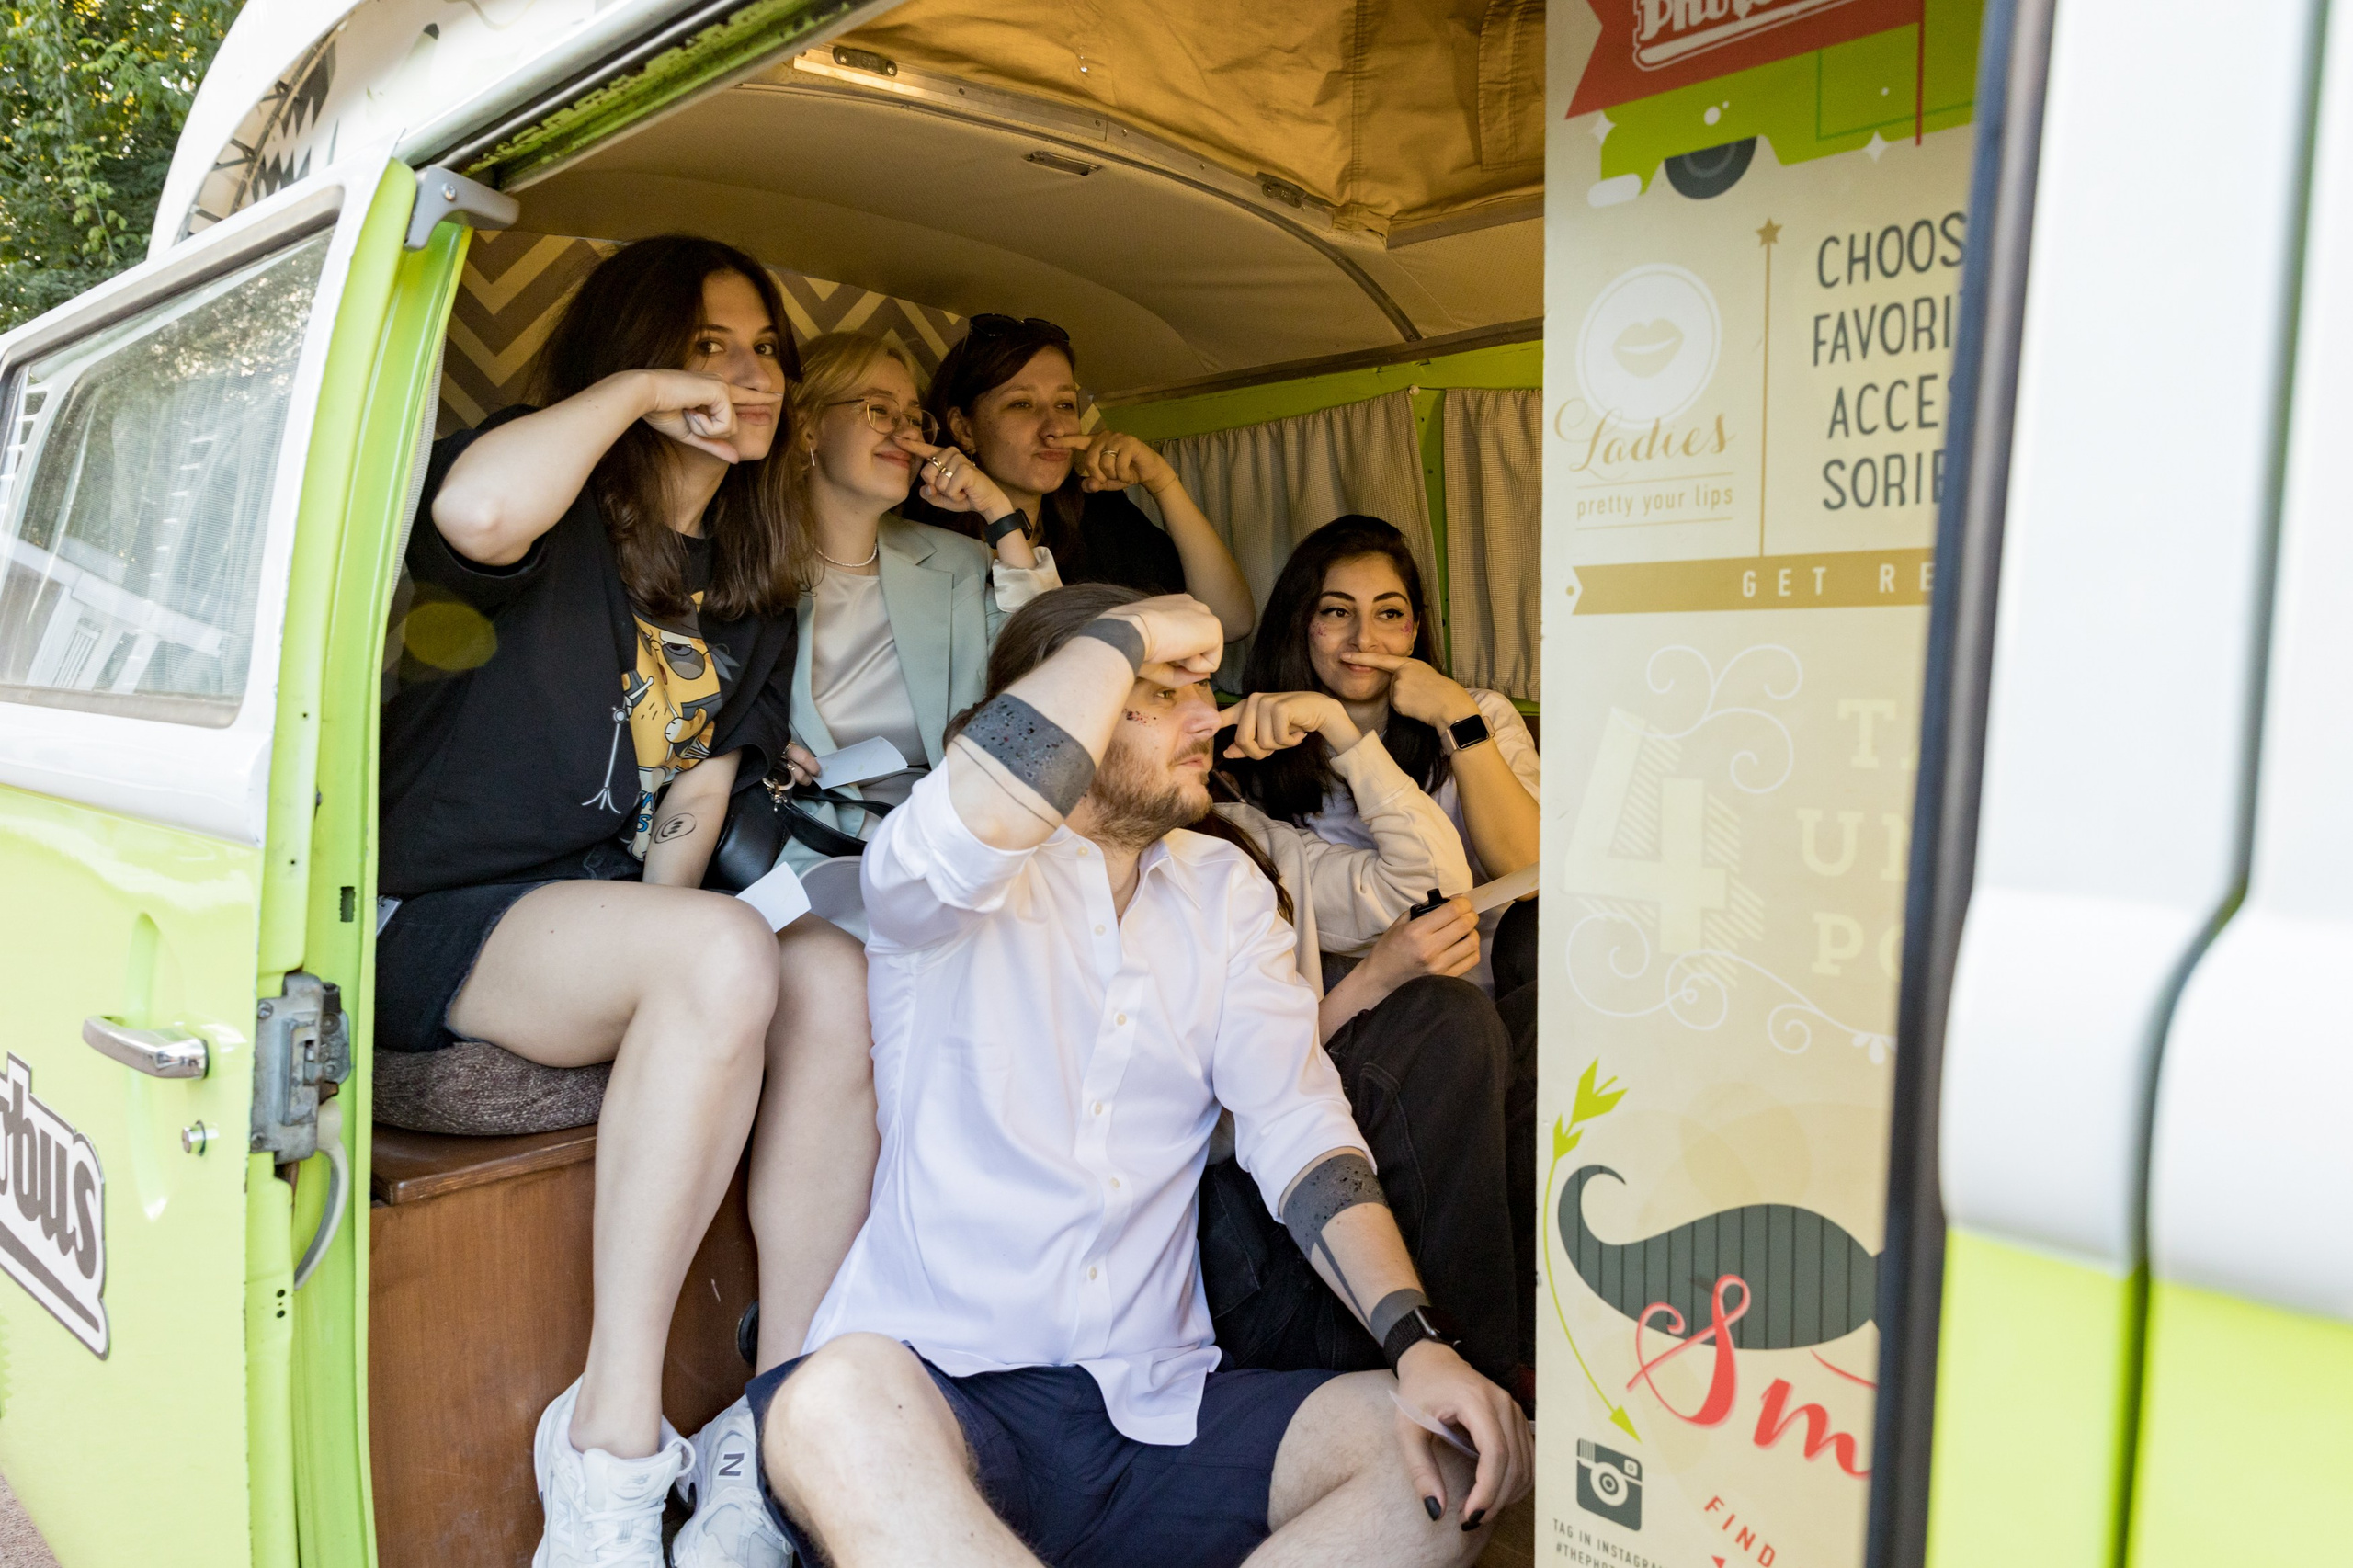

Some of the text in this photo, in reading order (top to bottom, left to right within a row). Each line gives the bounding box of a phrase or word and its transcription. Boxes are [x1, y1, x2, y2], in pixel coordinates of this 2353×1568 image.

[1813, 295, 1951, 368] FAVORI
[1827, 373, 1938, 439] ACCE
[1553, 398, 1736, 481] Ladies
[1576, 484, 1733, 521] pretty your lips
[1742, 567, 1826, 598] GET
[1552, 1517, 1668, 1568] TAG IN INSTAGR
[1704, 1495, 1776, 1568] FIND
